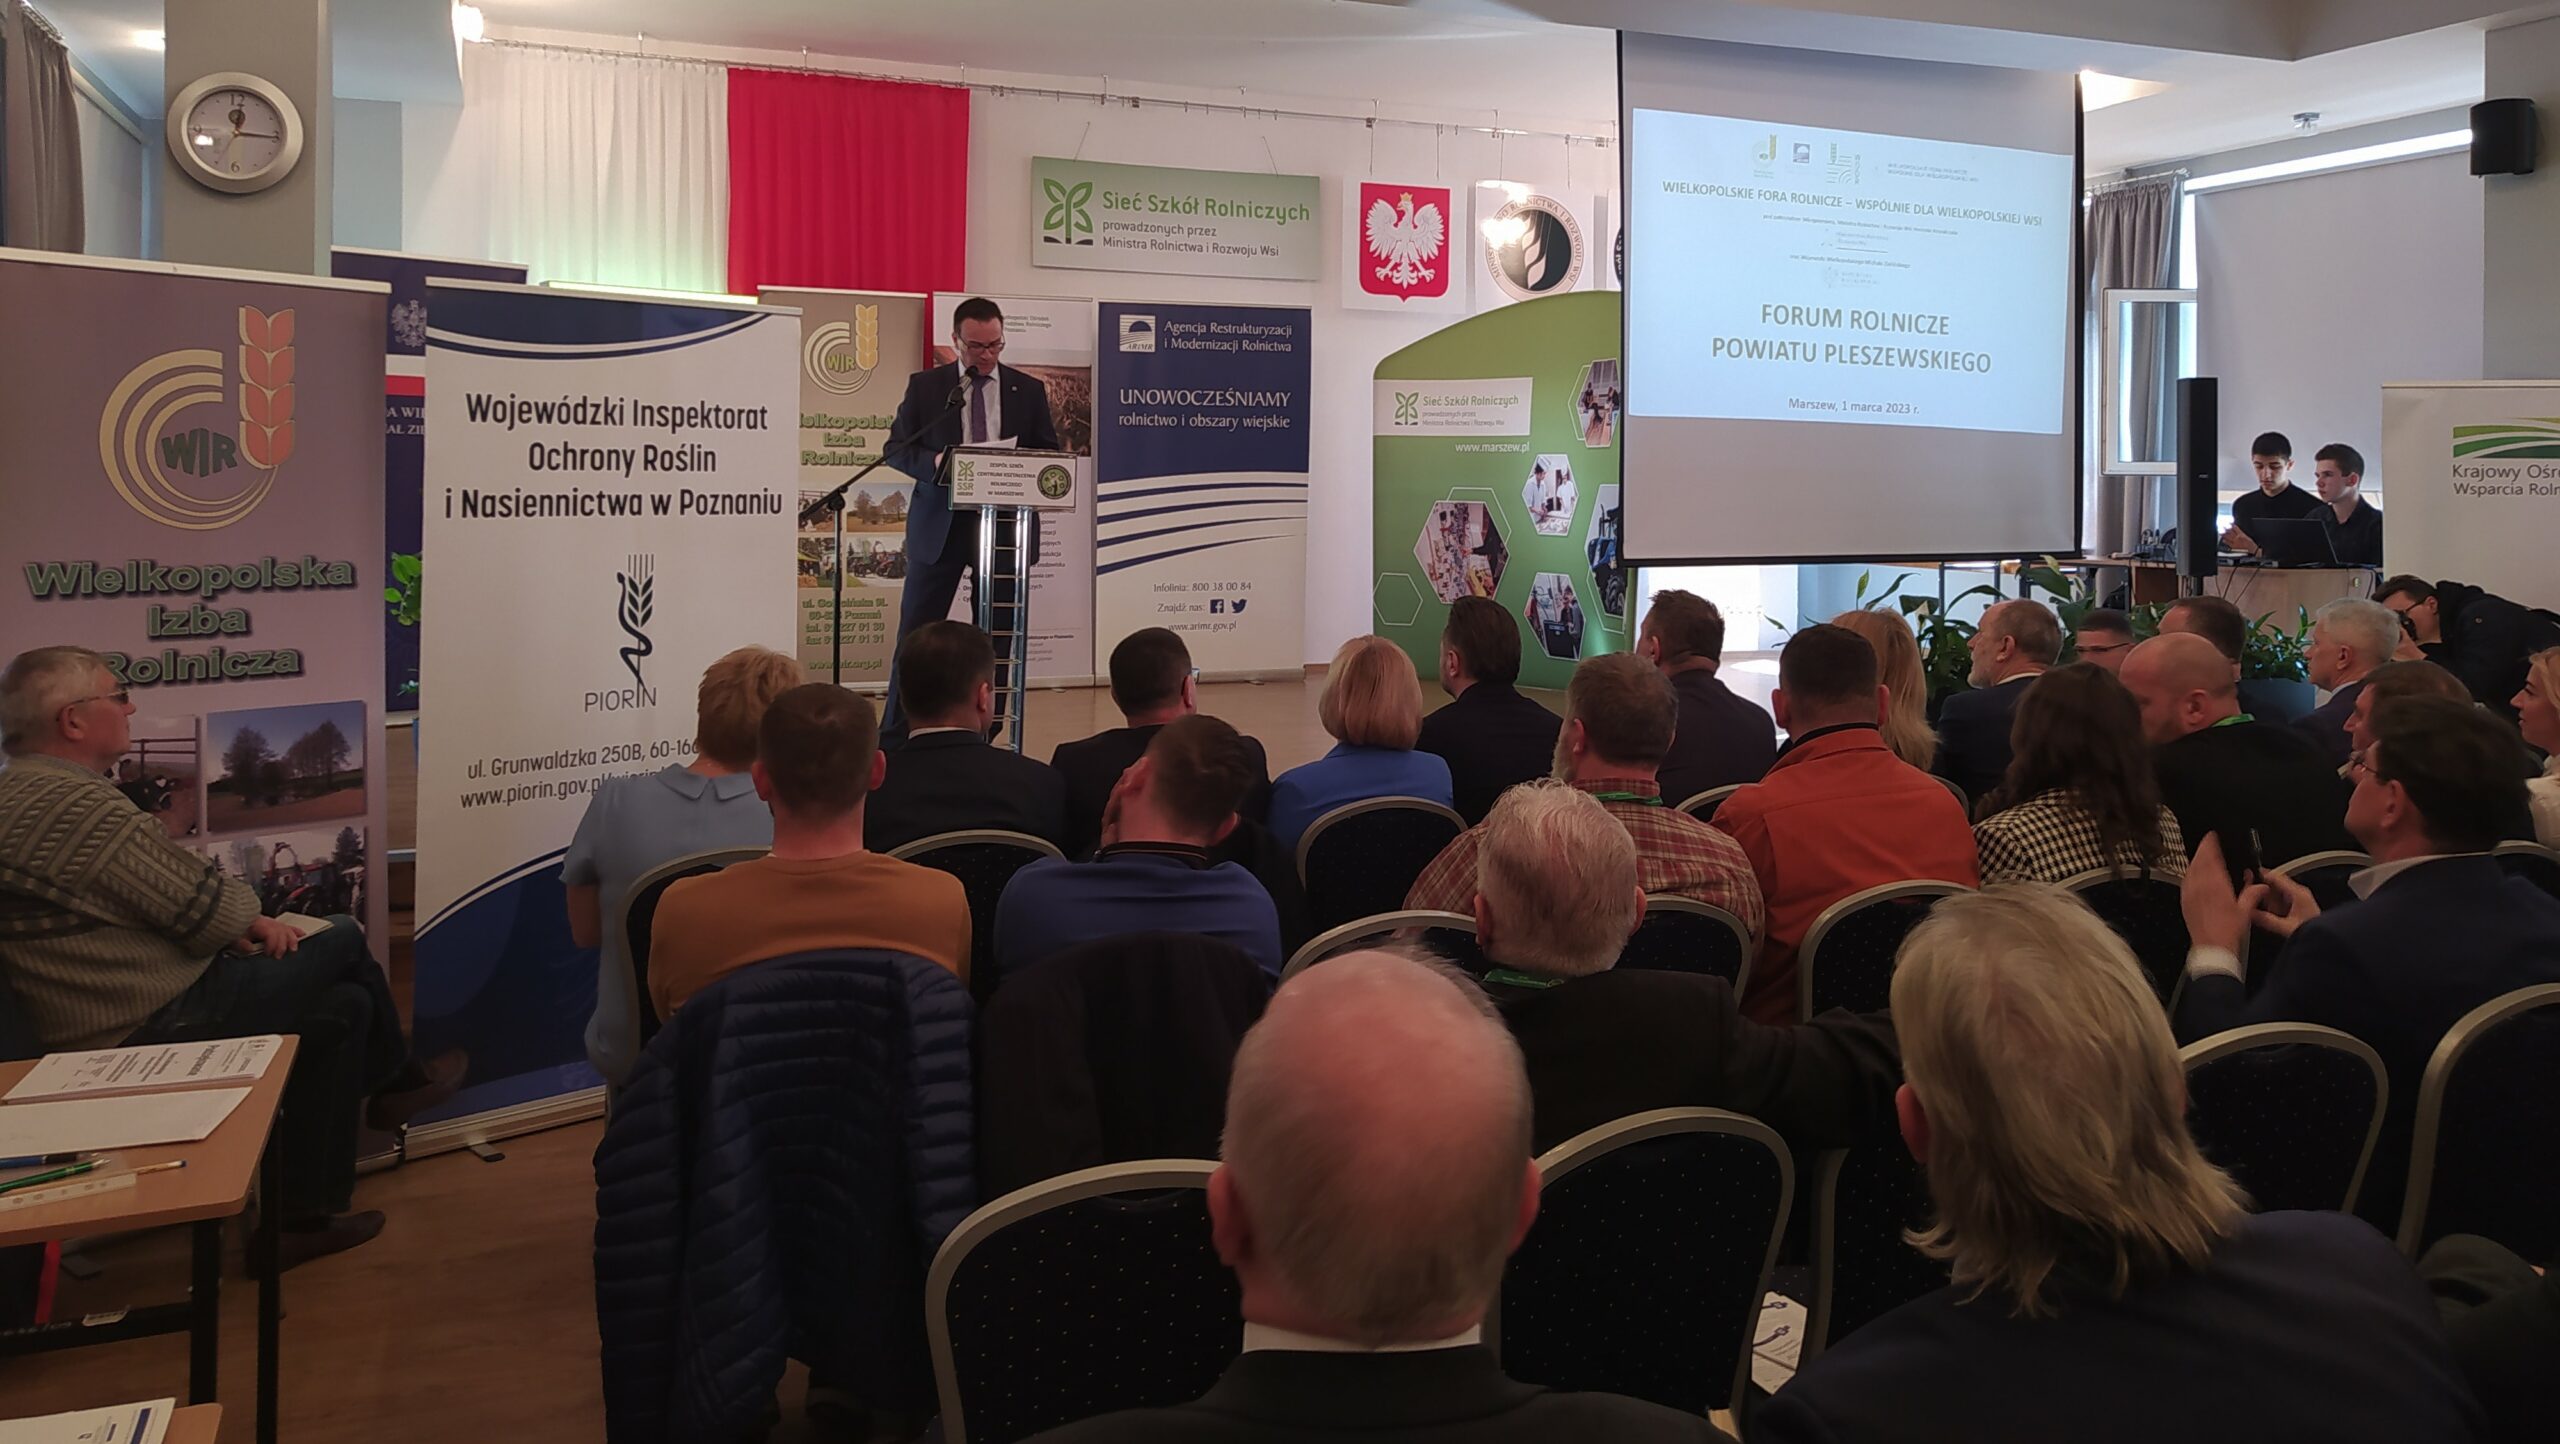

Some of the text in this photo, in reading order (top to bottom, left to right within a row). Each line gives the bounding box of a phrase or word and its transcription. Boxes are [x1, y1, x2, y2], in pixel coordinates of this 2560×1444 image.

[230, 93, 245, 107] 12
[230, 160, 240, 173] 6
[1102, 191, 1310, 226] Sieć Szkół Rolniczych
[1662, 181, 1754, 199] WIELKOPOLSKIE
[1757, 189, 1788, 203] FORA
[1790, 193, 1843, 208] ROLNICZE
[1855, 197, 1911, 214] WSPÓLNIE
[1913, 203, 1935, 216] DLA
[1937, 206, 2021, 225] WIELKOPOLSKIEJ
[2023, 214, 2043, 226] WSI
[1102, 220, 1217, 238] prowadzonych przez
[1102, 236, 1148, 250] Ministra
[1150, 239, 1204, 253] Rolnictwa
[1212, 242, 1258, 258] Rozwoju
[1260, 245, 1280, 257] Wsi
[1761, 303, 1950, 335] FORUM ROLNICZE
[1164, 320, 1292, 339] Agencja Restrukturyzacji
[1171, 338, 1239, 354] Modernizacji
[1242, 340, 1292, 352] Rolnictwa
[1711, 337, 1992, 374] POWIATU PLESZEWSKIEGO
[827, 354, 857, 373] WIR
[1119, 387, 1292, 407] UNOWOCZEŚNIAMY
[1422, 394, 1519, 409] Sieć Szkół Rolniczych
[1788, 398, 1920, 414] Marszew, 1 marca 2023 r.
[465, 392, 768, 434] Wojewódzki Inspektorat
[1119, 412, 1178, 426] rolnictwo
[1189, 413, 1239, 432] obszary
[1242, 414, 1291, 432] wiejskie
[823, 432, 866, 448] Izba
[1455, 441, 1530, 453] www.marszew.pl
[161, 427, 238, 478] WIR
[529, 441, 717, 478] Ochrony Roślin
[2452, 464, 2521, 483] Krajowy
[957, 482, 974, 491] SSR
[2454, 482, 2524, 498] Wsparcia
[445, 487, 783, 518] i Nasiennictwa w Poznaniu
[25, 556, 355, 598] Wielkopolska
[1153, 582, 1252, 593] Infolinia: 800 38 00 84
[1157, 602, 1205, 615] Znajdź nas:
[147, 603, 249, 638] Izba
[584, 687, 657, 713] PIORIN
[467, 759, 486, 780] ul.
[491, 748, 597, 777] Grunwaldzka
[601, 743, 646, 762] 250B,
